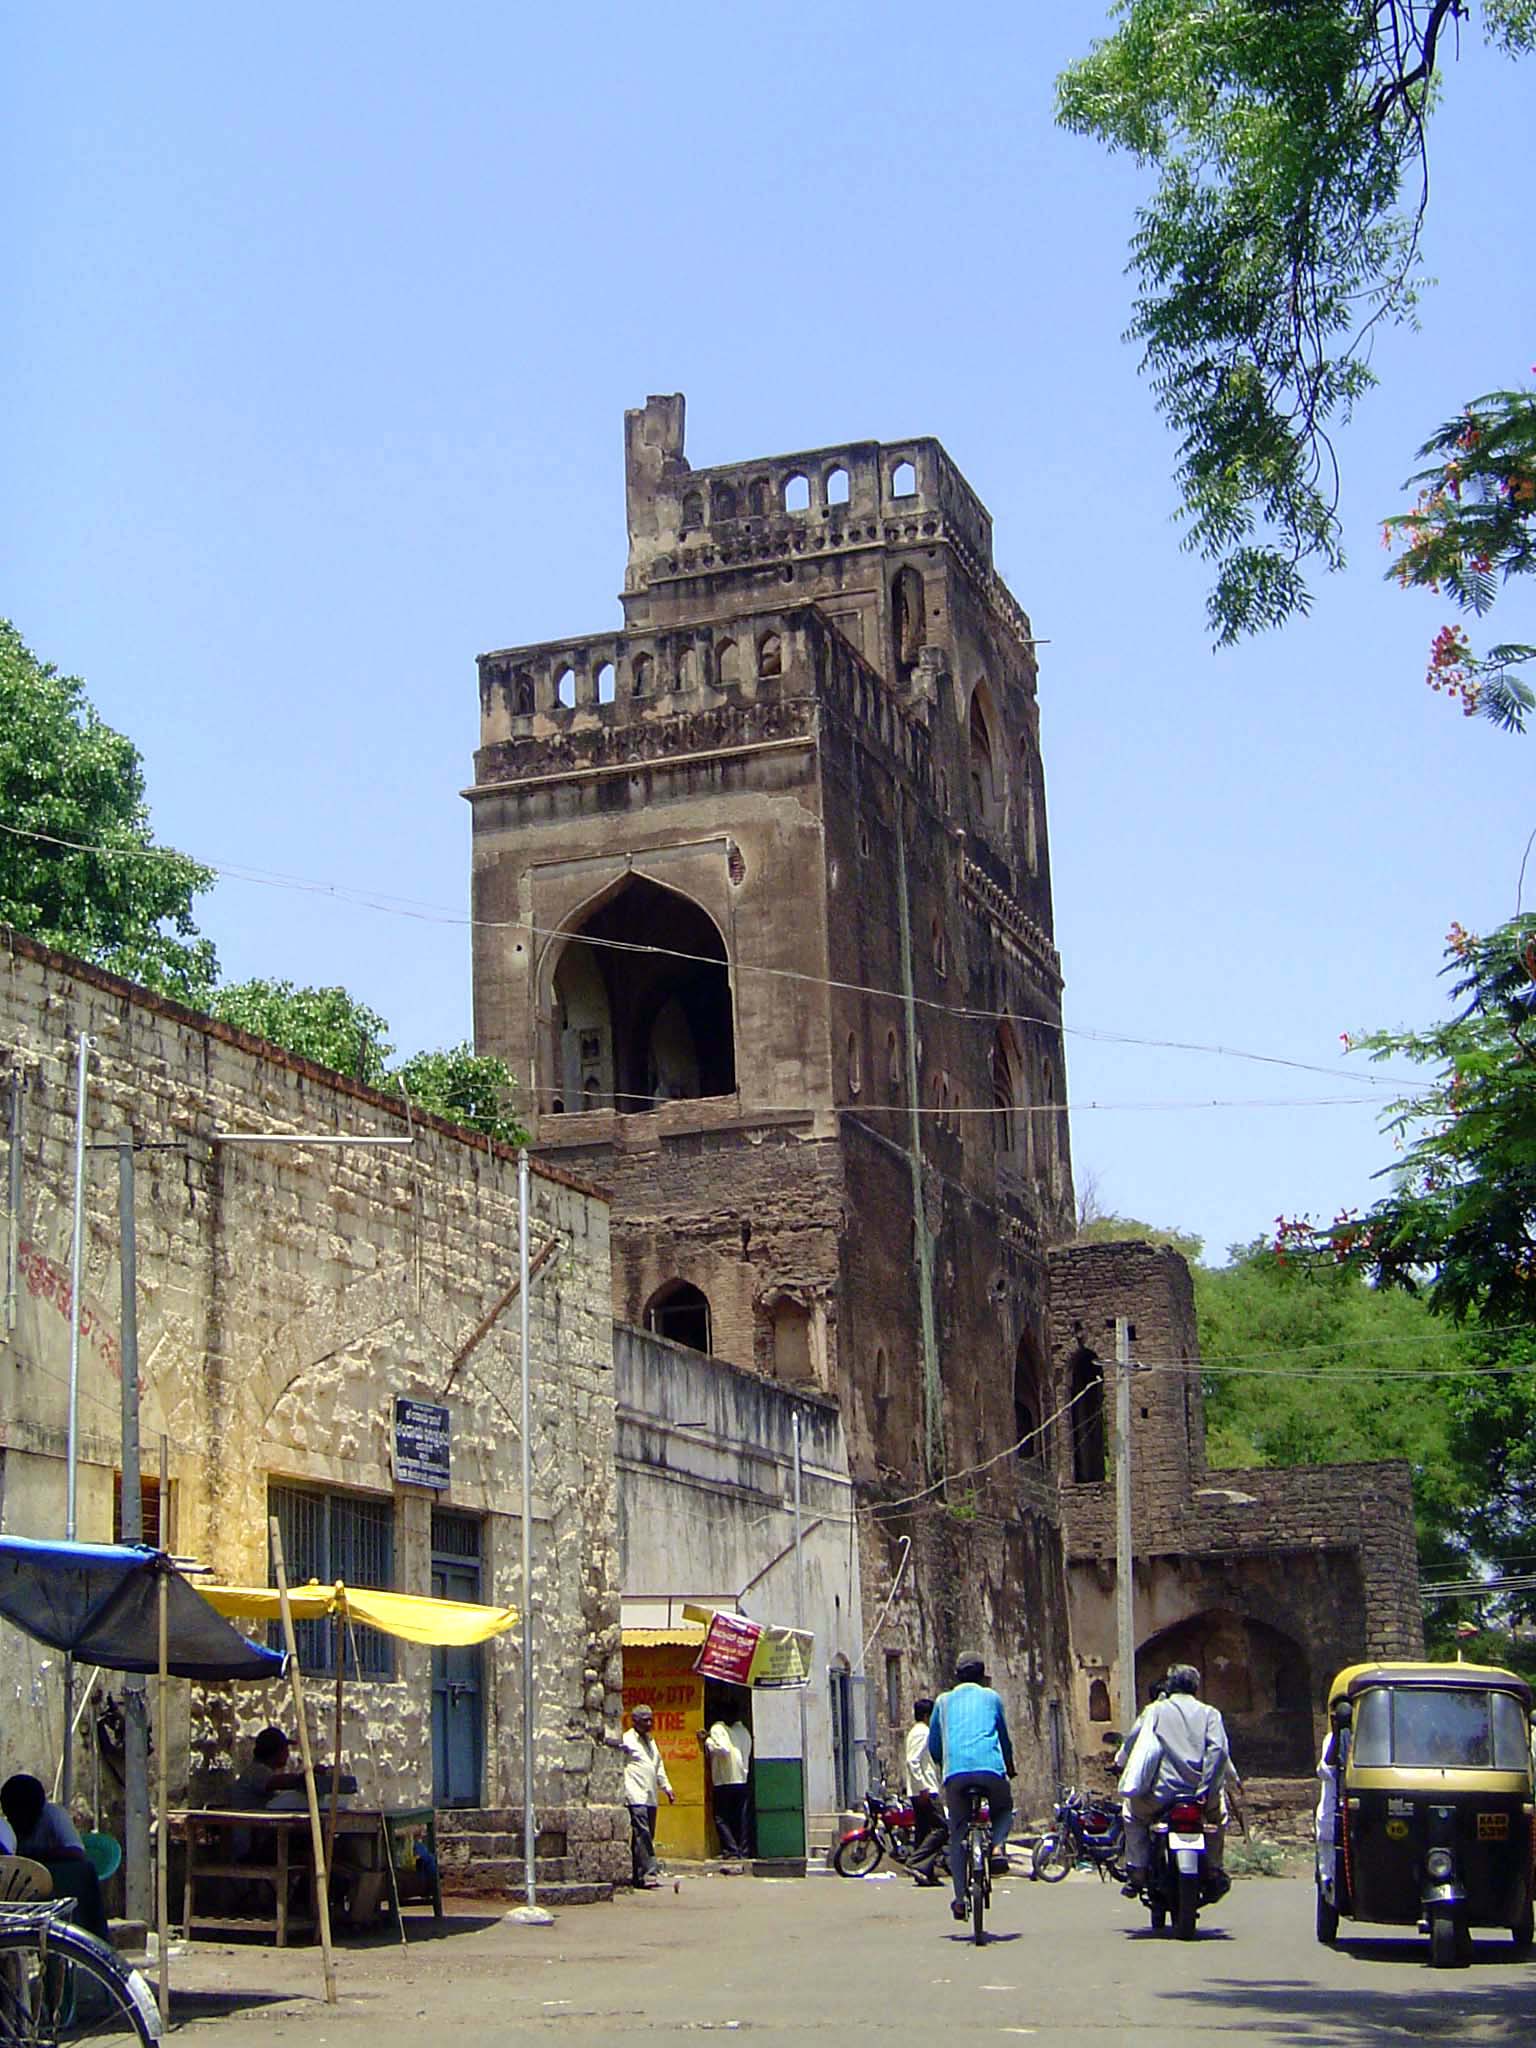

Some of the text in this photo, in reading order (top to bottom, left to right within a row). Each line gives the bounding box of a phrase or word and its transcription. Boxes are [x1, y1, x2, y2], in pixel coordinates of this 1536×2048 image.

[622, 1687, 656, 1707] EROX
[665, 1685, 695, 1705] DTP
[622, 1711, 686, 1732] CTRE
